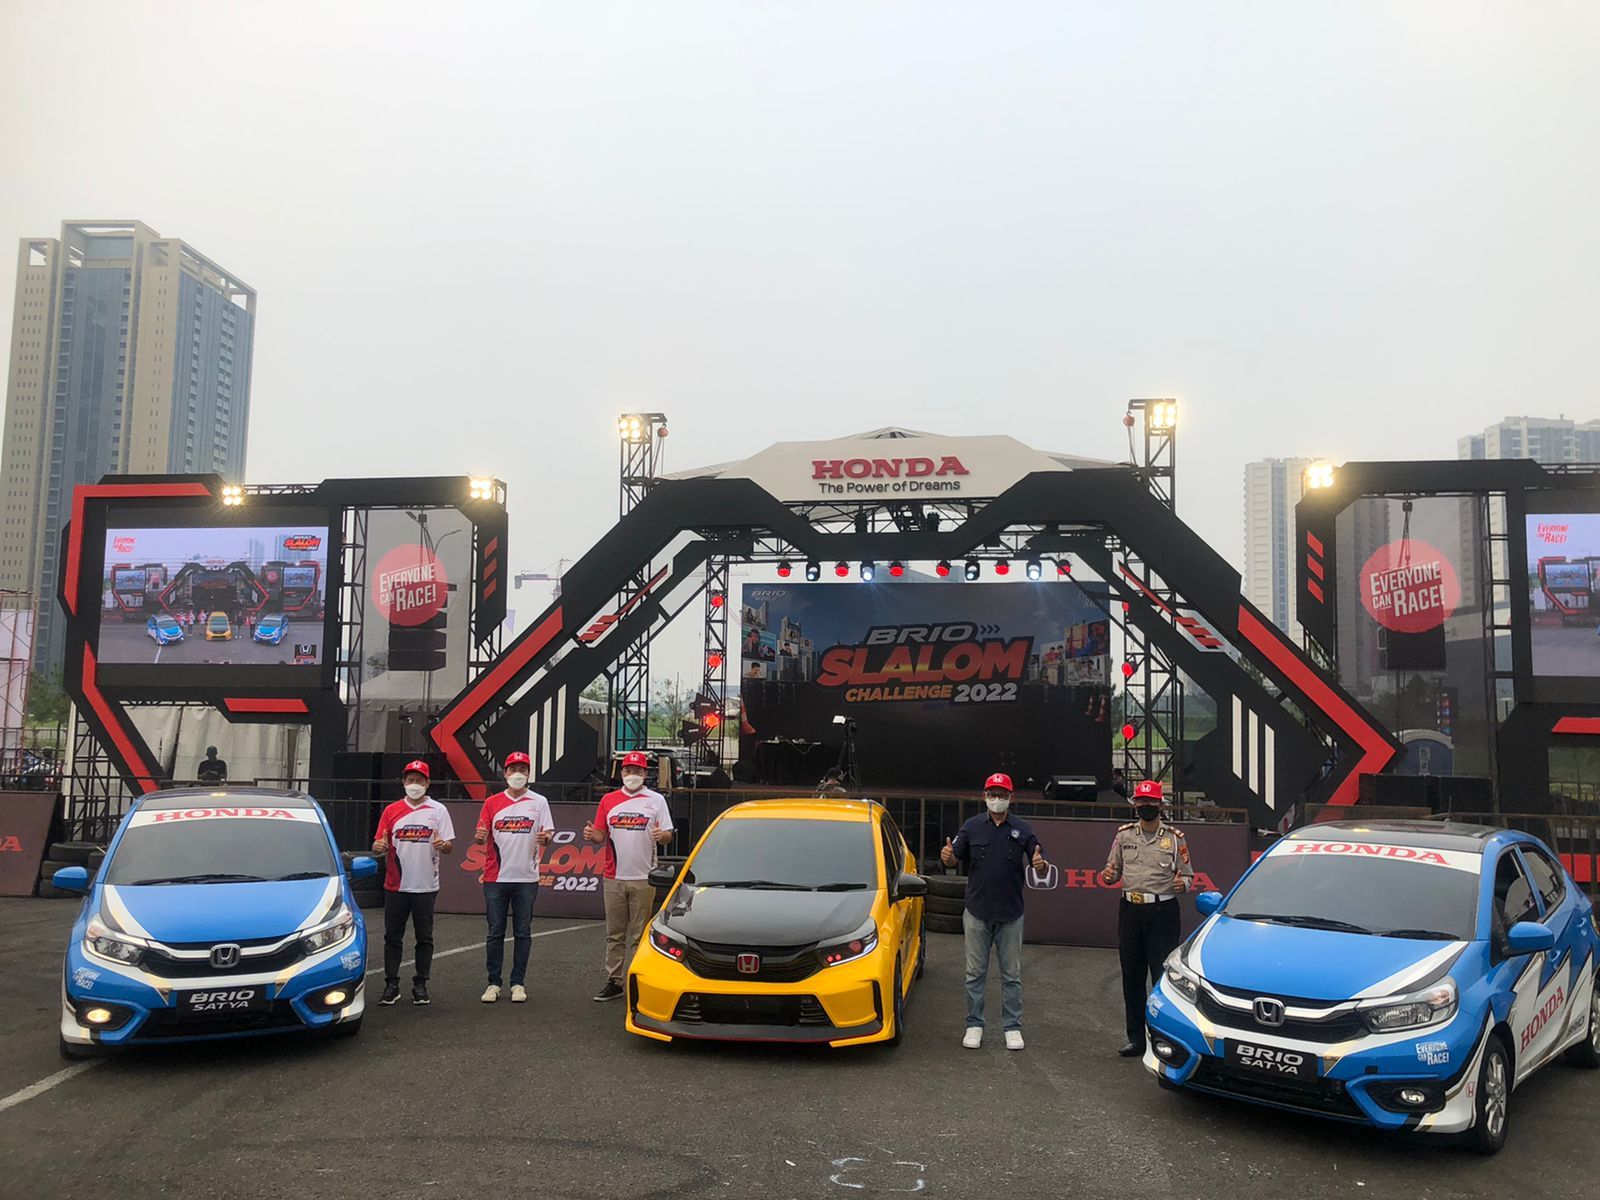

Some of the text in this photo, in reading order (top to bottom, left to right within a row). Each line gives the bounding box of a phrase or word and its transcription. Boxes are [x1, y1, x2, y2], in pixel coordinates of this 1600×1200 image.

[812, 456, 970, 480] HONDA
[819, 480, 961, 494] The Power of Dreams
[380, 563, 435, 593] EVERYONE
[1370, 561, 1441, 596] EVERYONE
[380, 584, 437, 612] CAN RACE!
[1373, 584, 1445, 617] CAN RACE!
[866, 625, 973, 645] BRIO
[816, 640, 1028, 686] SLALOM
[845, 683, 1018, 702] CHALLENGE 2022
[154, 807, 296, 822] HONDA
[610, 816, 649, 826] SLALOM
[396, 829, 433, 839] SLALOM
[495, 820, 534, 830] SLALOM
[460, 845, 606, 875] SLOM
[1290, 843, 1450, 865] HONDA
[553, 876, 599, 891] 2022
[189, 990, 255, 1003] BRIO
[192, 1001, 249, 1011] SATYA
[1520, 986, 1564, 1054] HONDA
[1236, 1044, 1303, 1066] BRIO
[1415, 1040, 1448, 1053] EVERYONE
[1240, 1056, 1298, 1075] SATYA
[1427, 1052, 1449, 1065] RACE!
